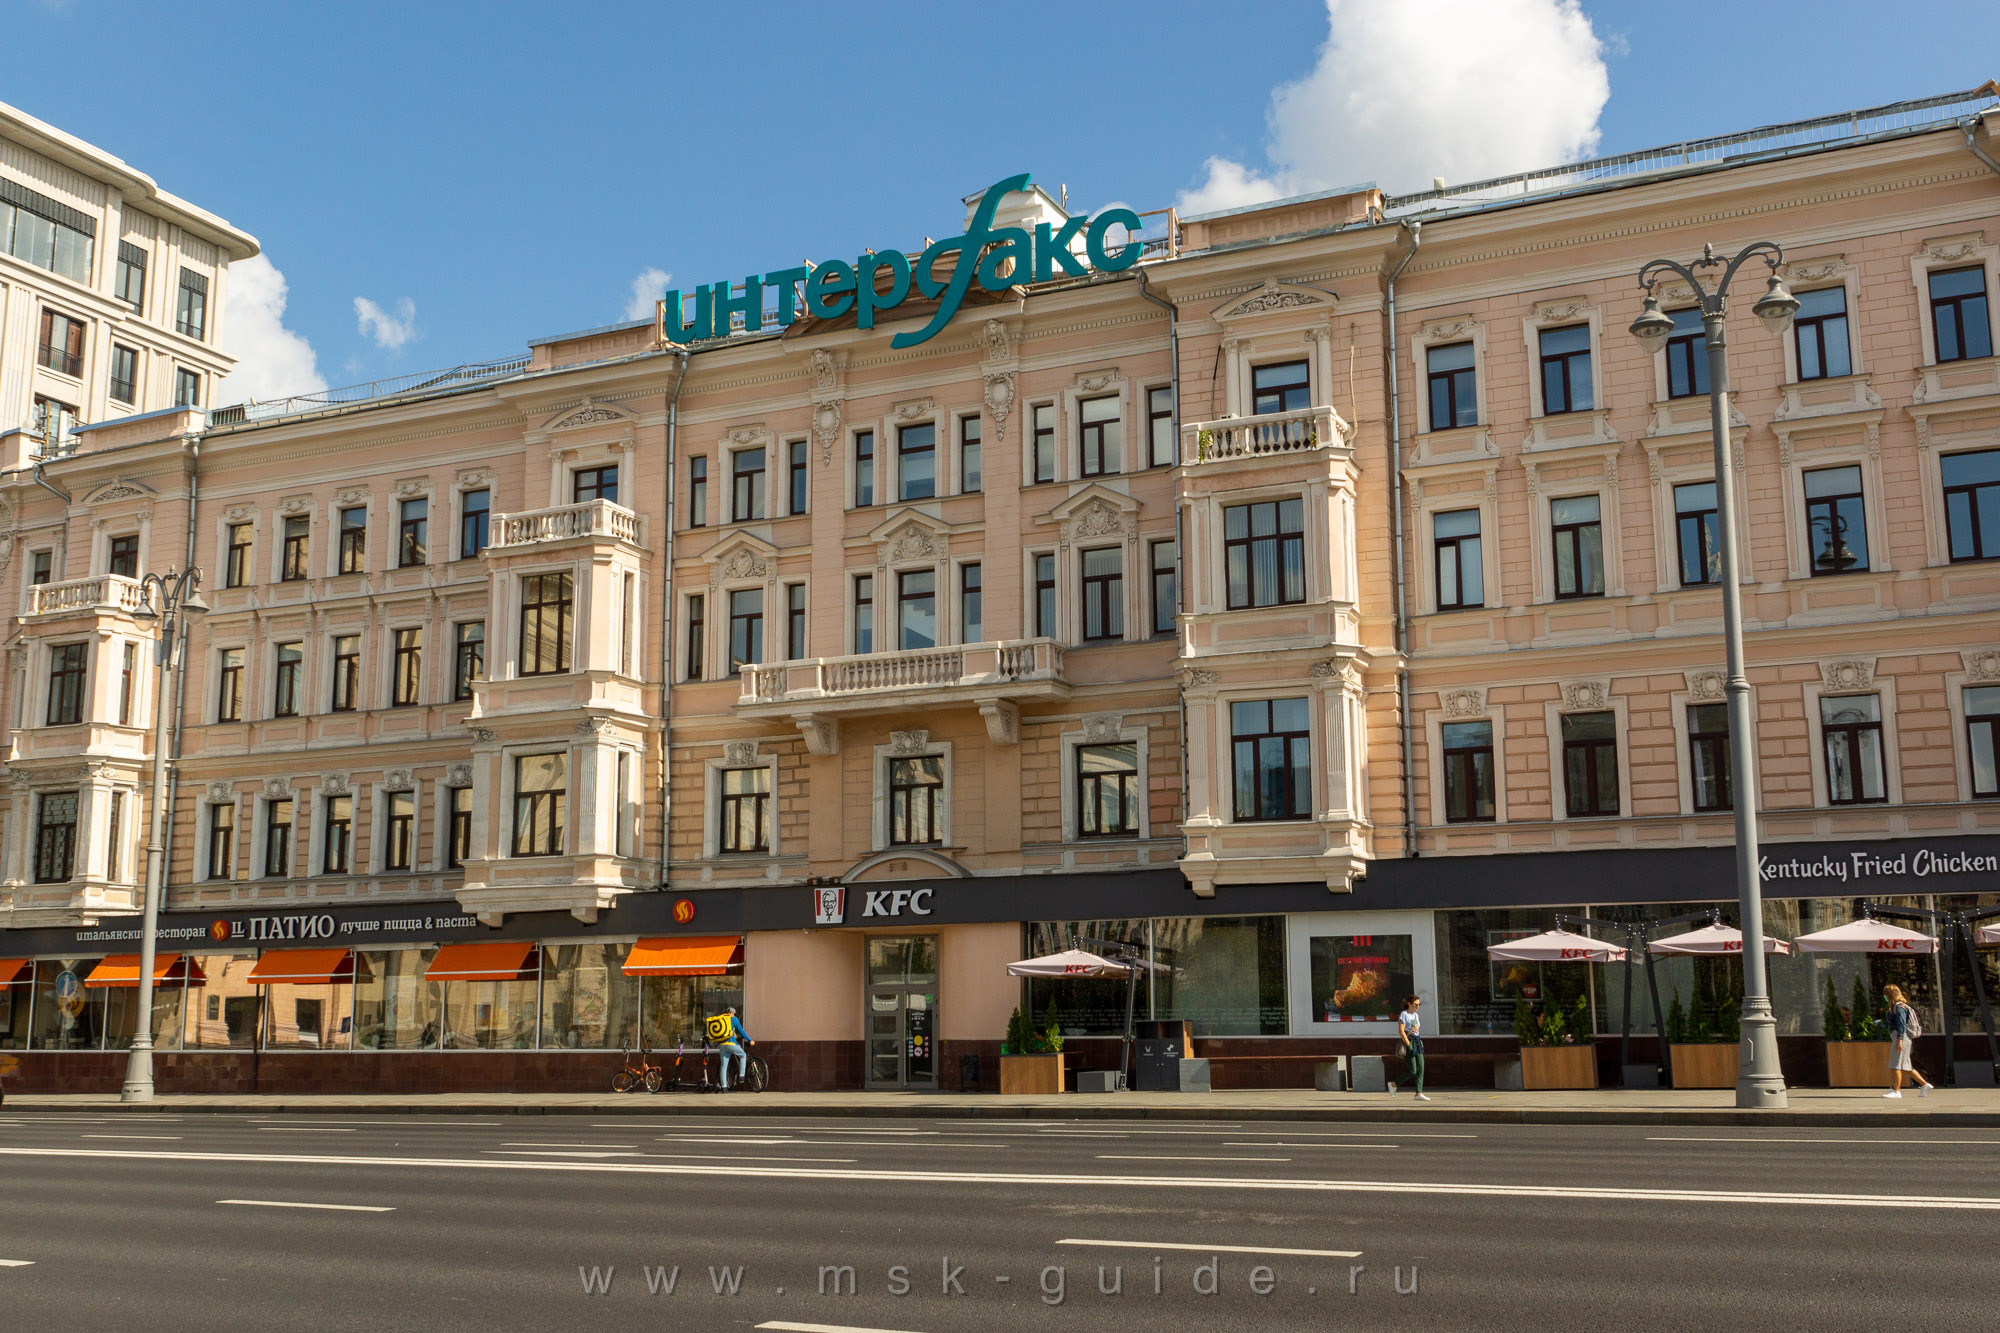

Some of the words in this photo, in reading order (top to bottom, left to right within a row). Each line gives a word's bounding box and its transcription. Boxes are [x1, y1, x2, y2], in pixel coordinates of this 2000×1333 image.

[1757, 855, 1847, 883] Kentucky
[1850, 852, 1907, 879] Fried
[1912, 849, 1998, 877] Chicken
[862, 888, 933, 917] KFC
[249, 914, 335, 940] ПАТИО
[339, 919, 380, 934] лучше
[383, 917, 423, 931] пицца
[425, 917, 433, 929] &
[435, 916, 477, 929] паста
[1722, 940, 1743, 950] KF
[1877, 938, 1915, 950] KFC
[1560, 948, 1593, 959] KFC
[1064, 964, 1092, 974] KFC
